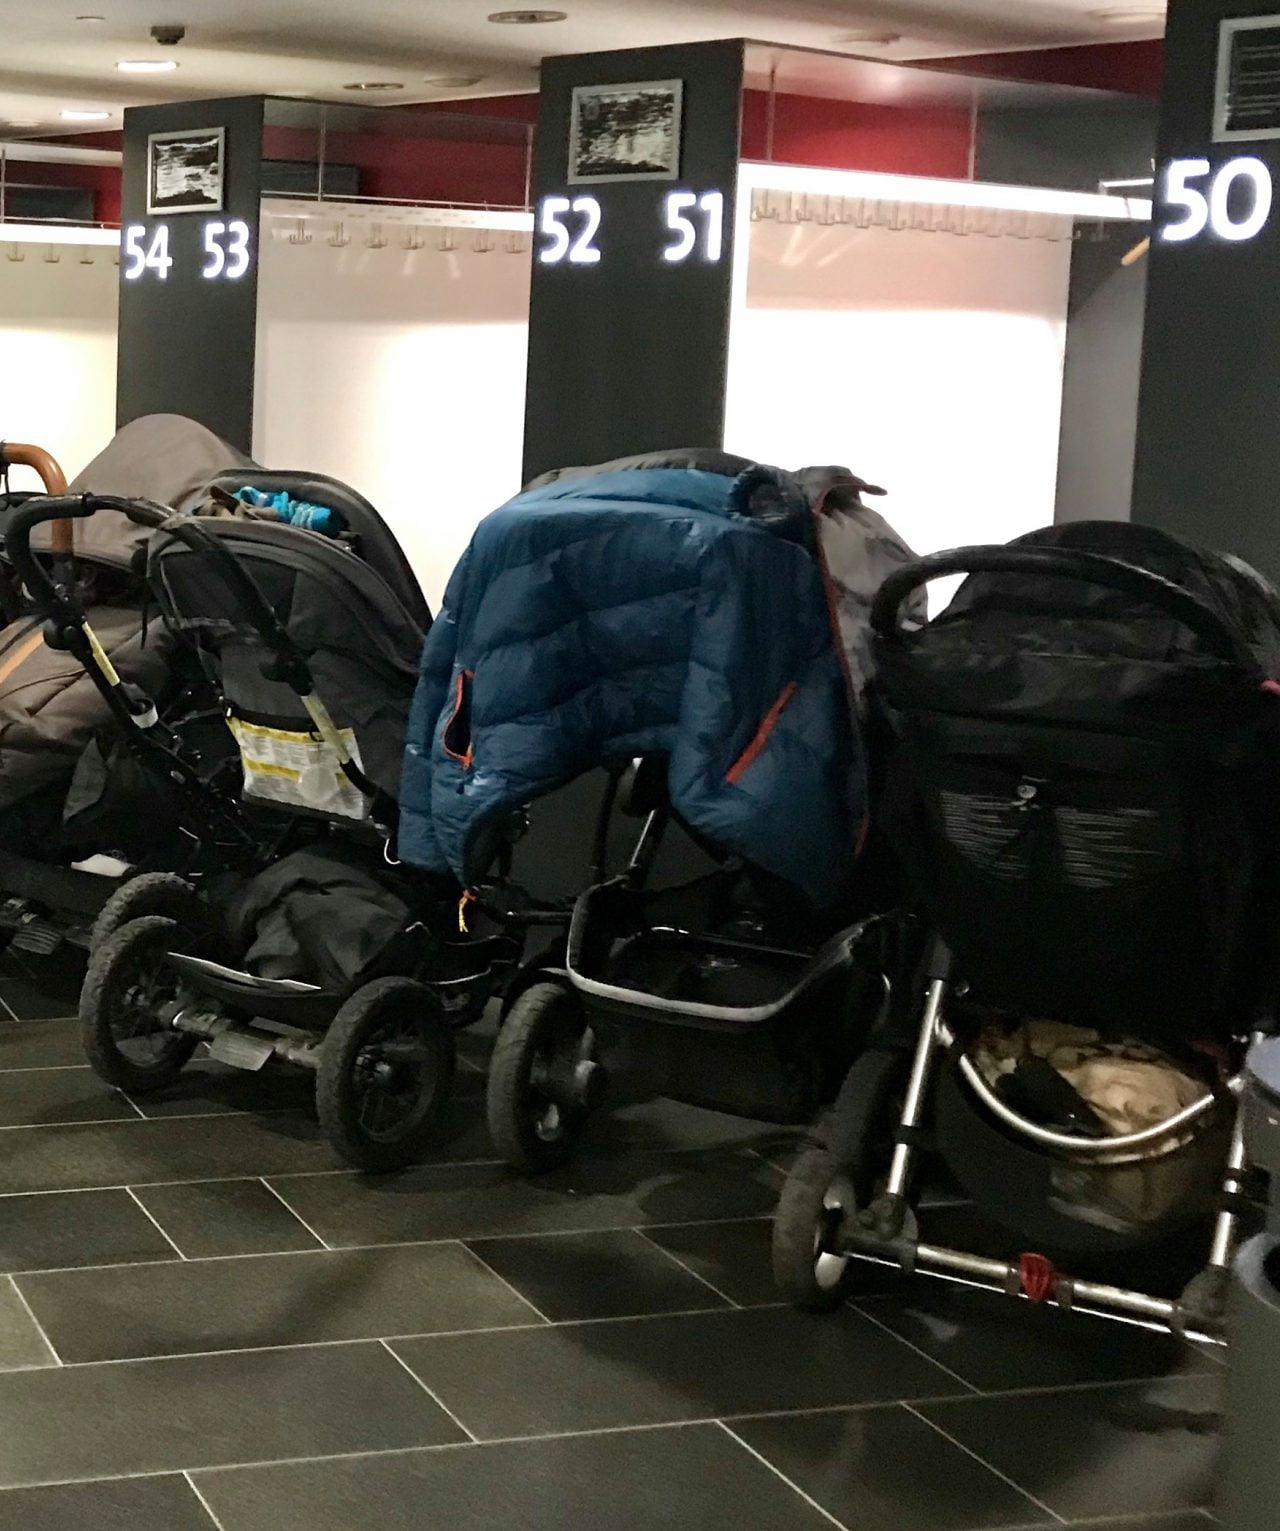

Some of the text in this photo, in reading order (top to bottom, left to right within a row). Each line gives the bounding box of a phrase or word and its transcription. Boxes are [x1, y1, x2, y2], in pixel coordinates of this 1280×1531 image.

[540, 192, 724, 263] 52 51
[1162, 157, 1273, 241] 50
[125, 221, 250, 279] 54 53
